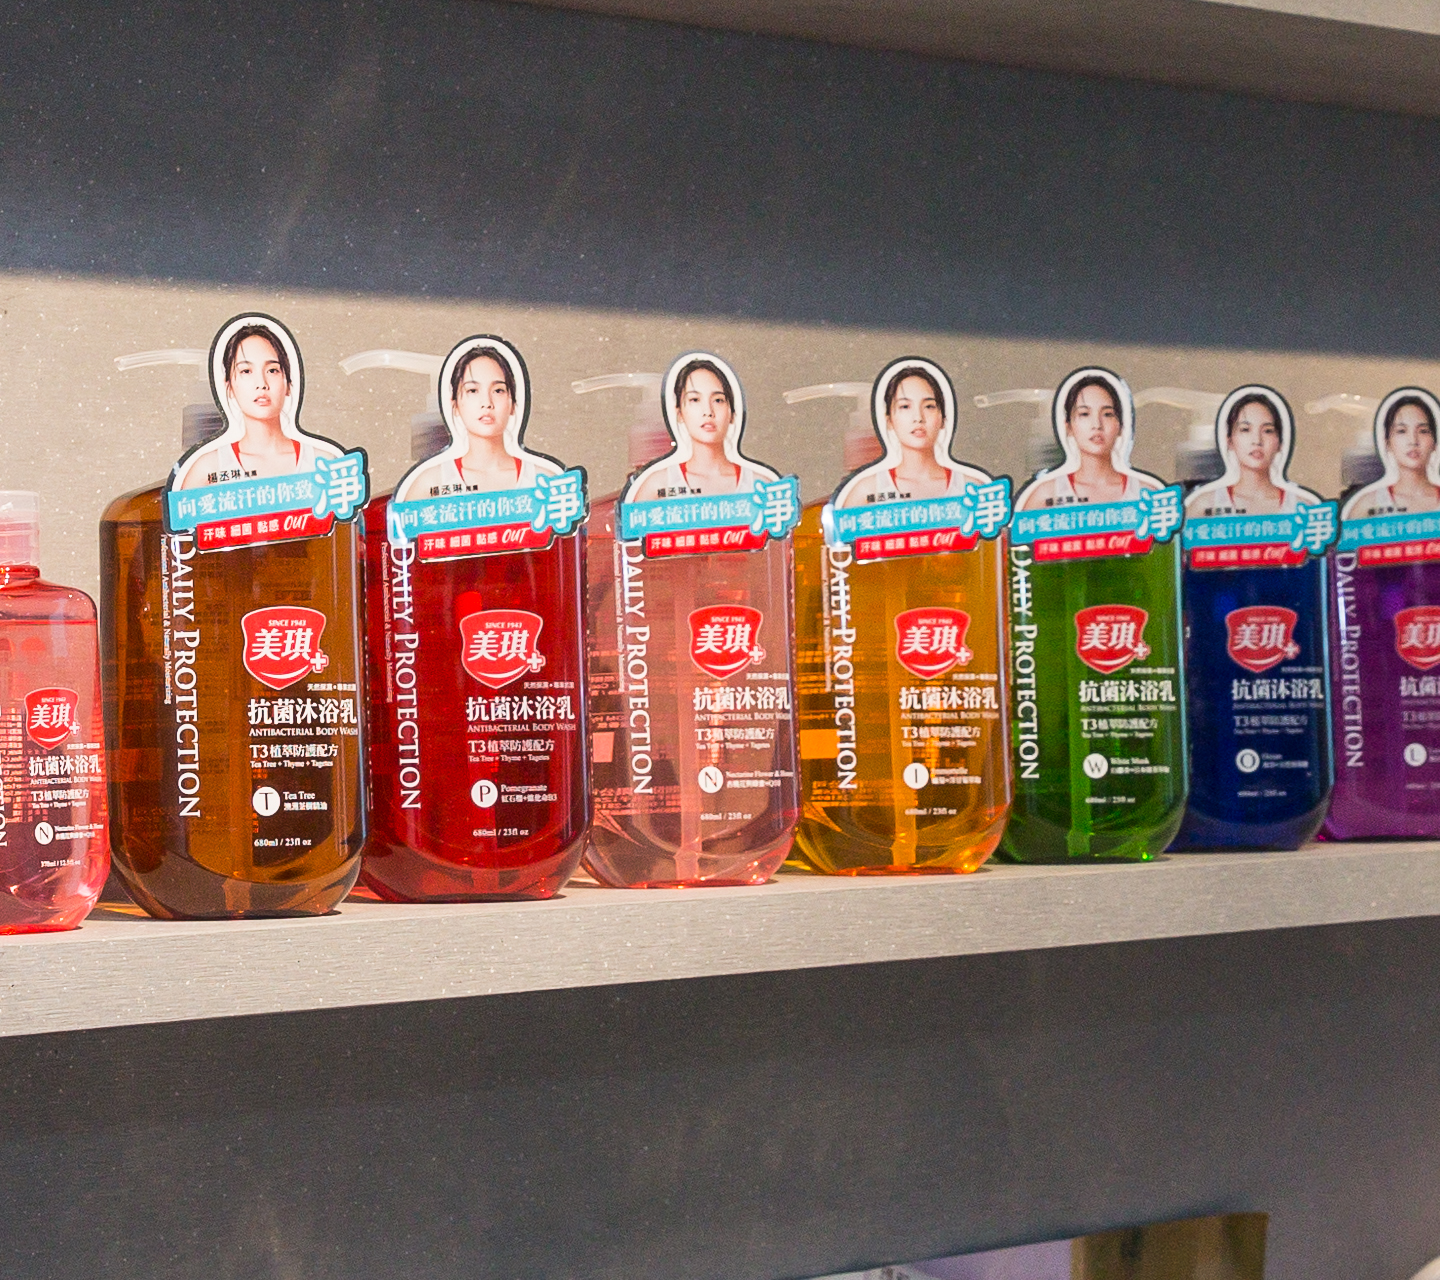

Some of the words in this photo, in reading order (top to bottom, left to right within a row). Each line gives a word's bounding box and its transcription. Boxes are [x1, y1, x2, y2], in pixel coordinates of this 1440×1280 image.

[390, 543, 417, 626] DAILY
[250, 629, 313, 661] 美琪
[468, 630, 529, 661] 美琪
[695, 624, 752, 654] 美琪
[902, 626, 959, 654] 美琪
[1080, 622, 1135, 650] 美琪
[692, 687, 792, 711] 抗菌沐浴乳
[899, 686, 999, 711] 抗菌沐浴乳
[1015, 624, 1039, 779] PROTECTION
[1079, 680, 1176, 703] 抗菌沐浴乳
[1340, 625, 1365, 768] PROTECTION
[173, 629, 201, 818] PROTECTION
[248, 698, 357, 725] 抗菌沐浴乳
[394, 631, 421, 810] PROTECTION
[466, 696, 575, 722] 抗菌沐浴乳
[626, 624, 653, 795] PROTECTION
[249, 727, 314, 736] ANTIBACTERIAL
[316, 727, 338, 735] BODY
[29, 755, 101, 776] 抗菌沐浴乳
